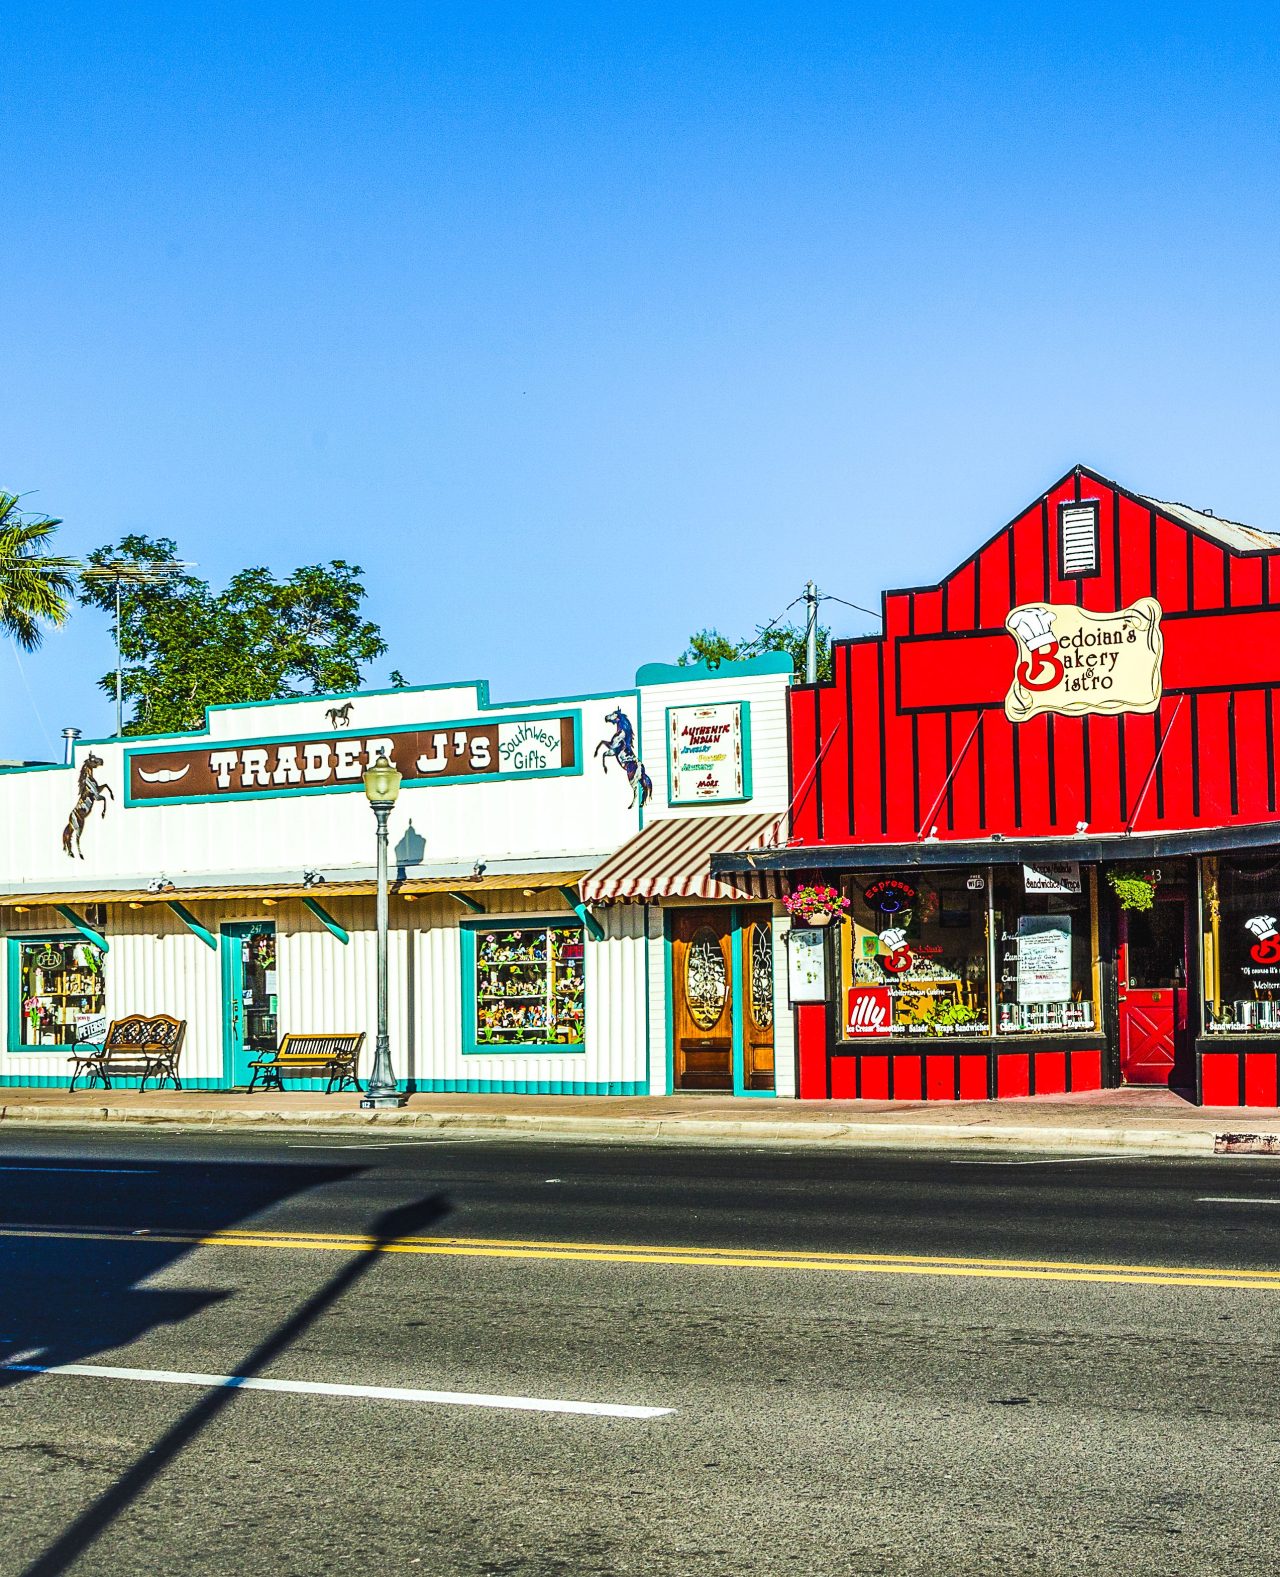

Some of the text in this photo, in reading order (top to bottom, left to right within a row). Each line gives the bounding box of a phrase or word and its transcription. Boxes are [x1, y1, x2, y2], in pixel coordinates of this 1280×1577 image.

[498, 725, 560, 760] Southwest
[689, 735, 721, 746] INDIAN
[209, 737, 396, 789] TRADER
[514, 750, 547, 769] Gifts
[864, 879, 915, 899] Espresso
[250, 924, 262, 933] 247
[38, 951, 62, 967] OPEN
[850, 995, 886, 1028] illy
